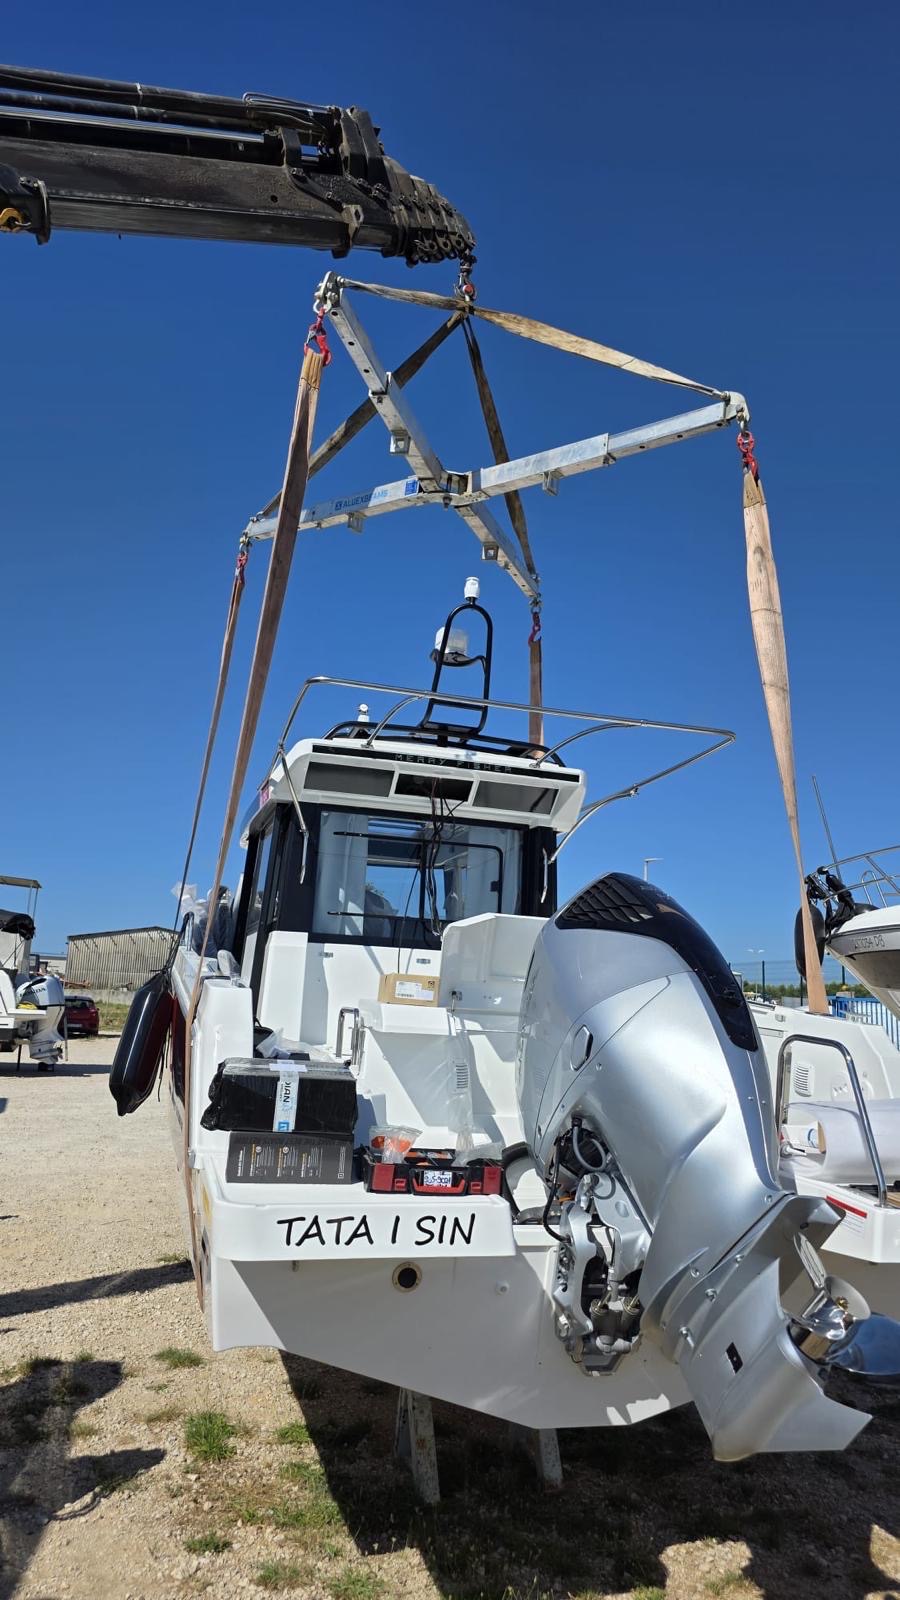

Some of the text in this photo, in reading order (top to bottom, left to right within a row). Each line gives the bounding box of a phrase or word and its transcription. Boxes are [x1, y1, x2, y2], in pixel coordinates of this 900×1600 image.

[395, 754, 512, 773] MERRY FISHER
[276, 1213, 476, 1247] TATA I SIN
